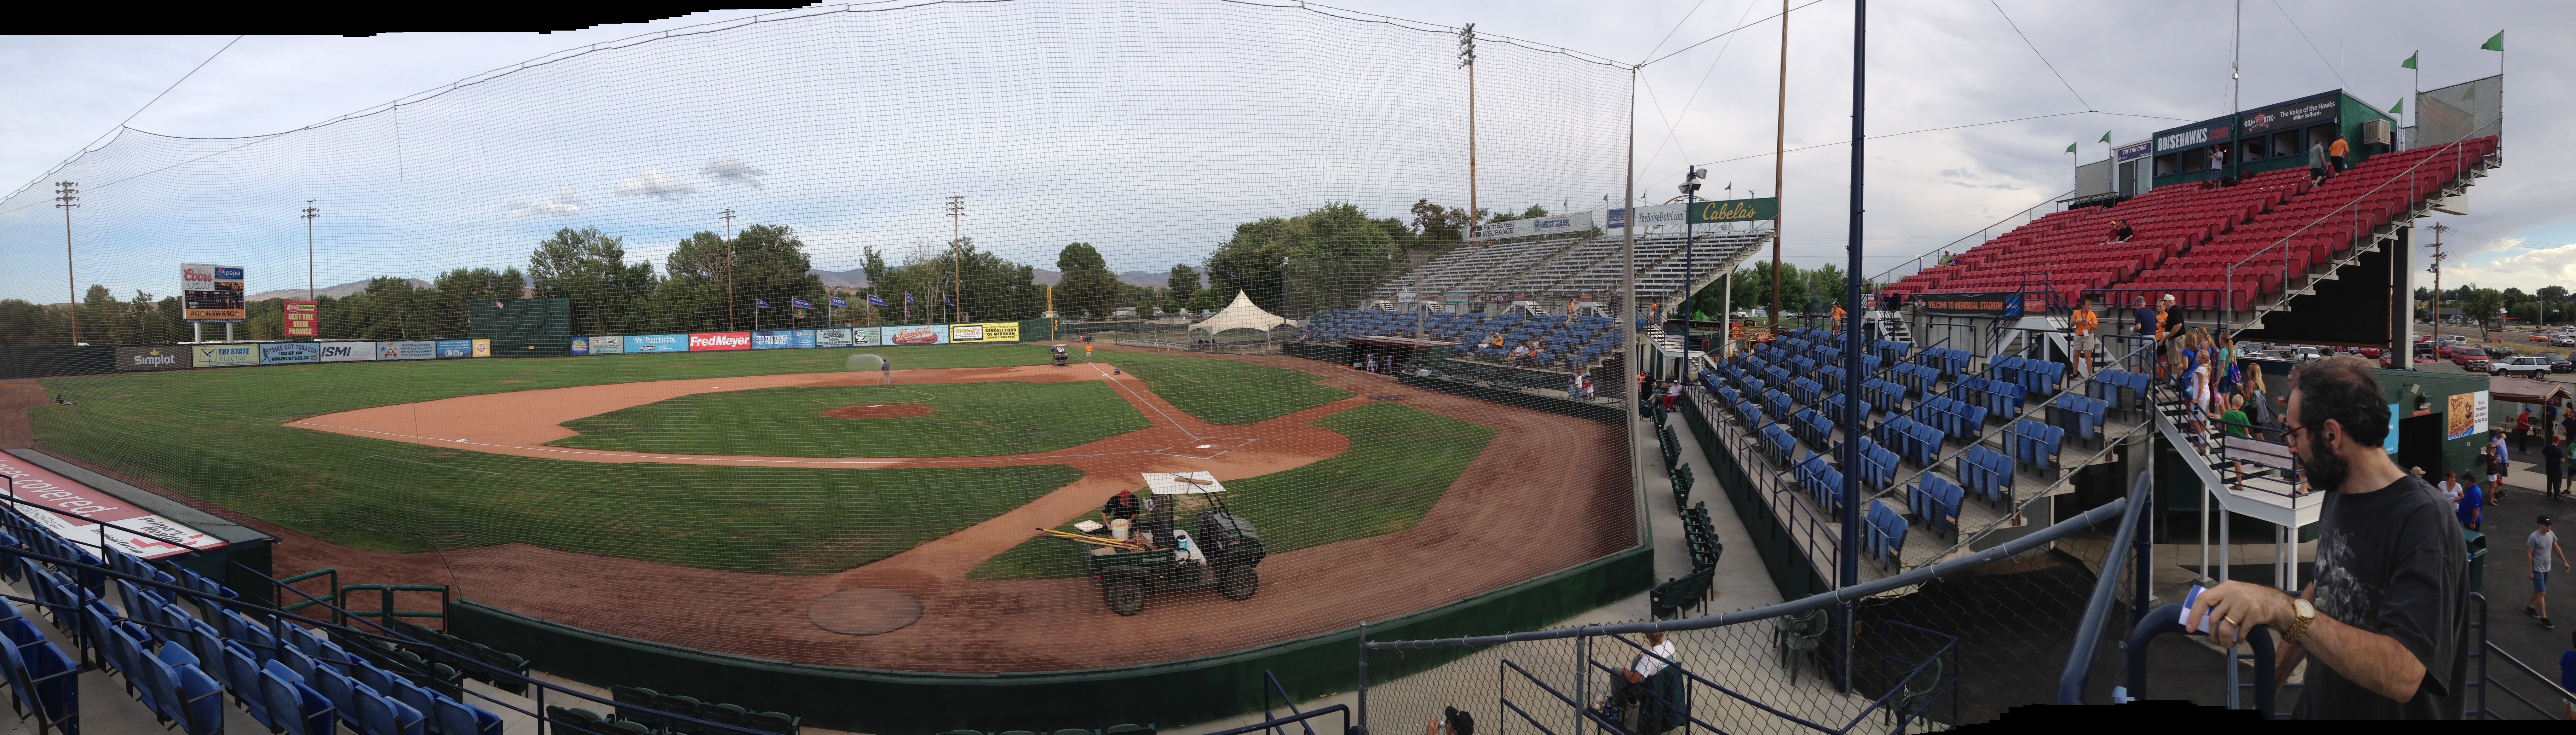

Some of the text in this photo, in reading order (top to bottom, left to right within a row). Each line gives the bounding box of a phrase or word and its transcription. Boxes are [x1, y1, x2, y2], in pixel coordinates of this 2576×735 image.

[2318, 101, 2335, 110] Hawks
[2158, 127, 2228, 151] BOISEHAWKS.com
[1639, 211, 1684, 223] TheBoiseHotel.com
[1703, 202, 1756, 221] Cabela's
[1540, 219, 1570, 229] WESTMARK
[1483, 228, 1514, 237] INSURANCE
[183, 269, 213, 282] Coors
[1955, 301, 1979, 310] MEMORIAL
[1980, 301, 2003, 310] STADIUM
[897, 325, 931, 340] Leinenkugel's
[267, 345, 283, 354] STRIKE
[296, 344, 318, 354] TOBACCO!
[321, 347, 351, 356] ISMI
[135, 355, 175, 367] Simplot
[2451, 396, 2463, 406] Ozark
[12, 479, 120, 518] covered.
[138, 517, 188, 535] Primary
[140, 526, 183, 543] Health
[91, 529, 144, 554] Medical Group
